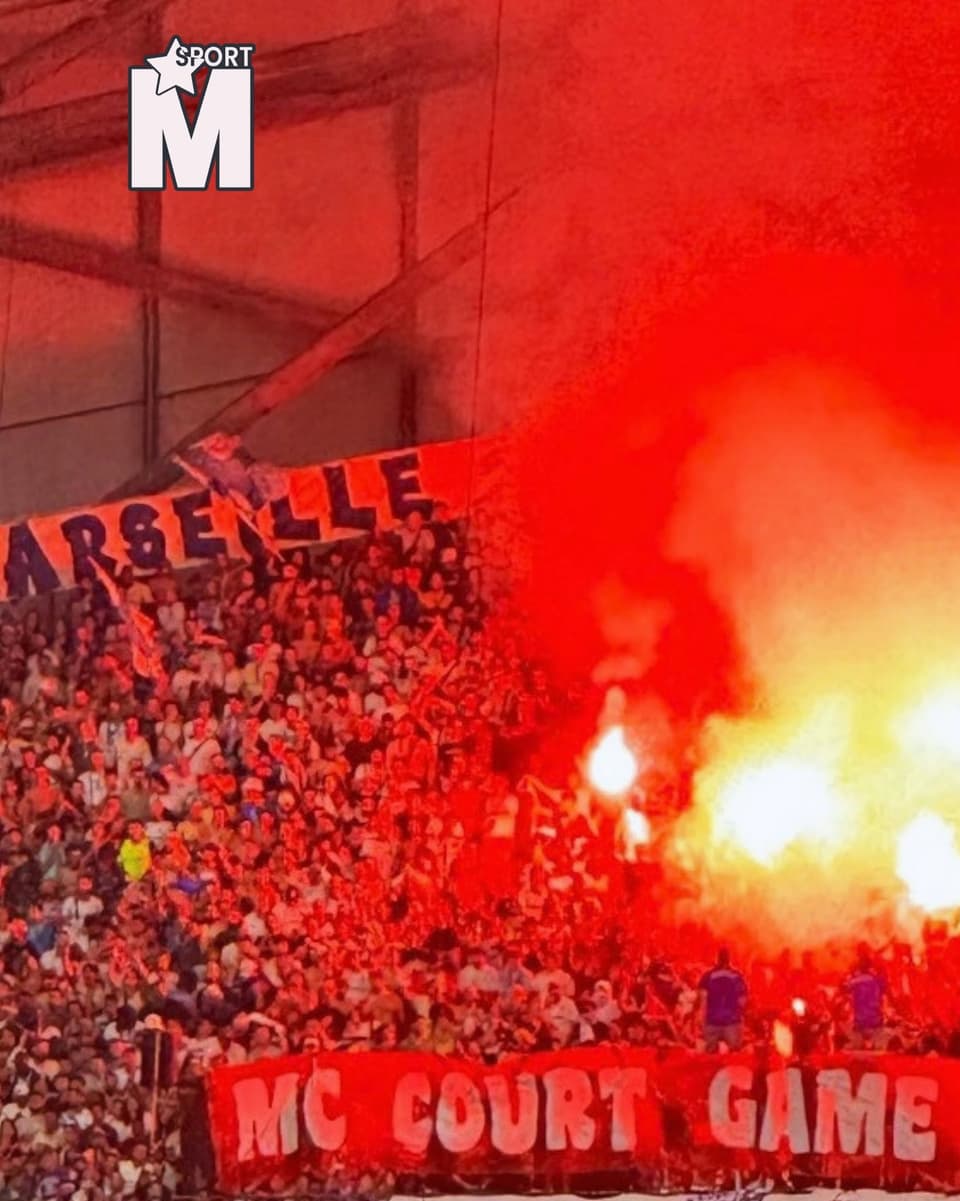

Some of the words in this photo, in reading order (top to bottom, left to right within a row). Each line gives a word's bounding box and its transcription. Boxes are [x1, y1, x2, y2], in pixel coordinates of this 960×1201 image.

[232, 1067, 347, 1163] MC
[392, 1065, 647, 1156] COURT
[708, 1065, 939, 1163] GAME
